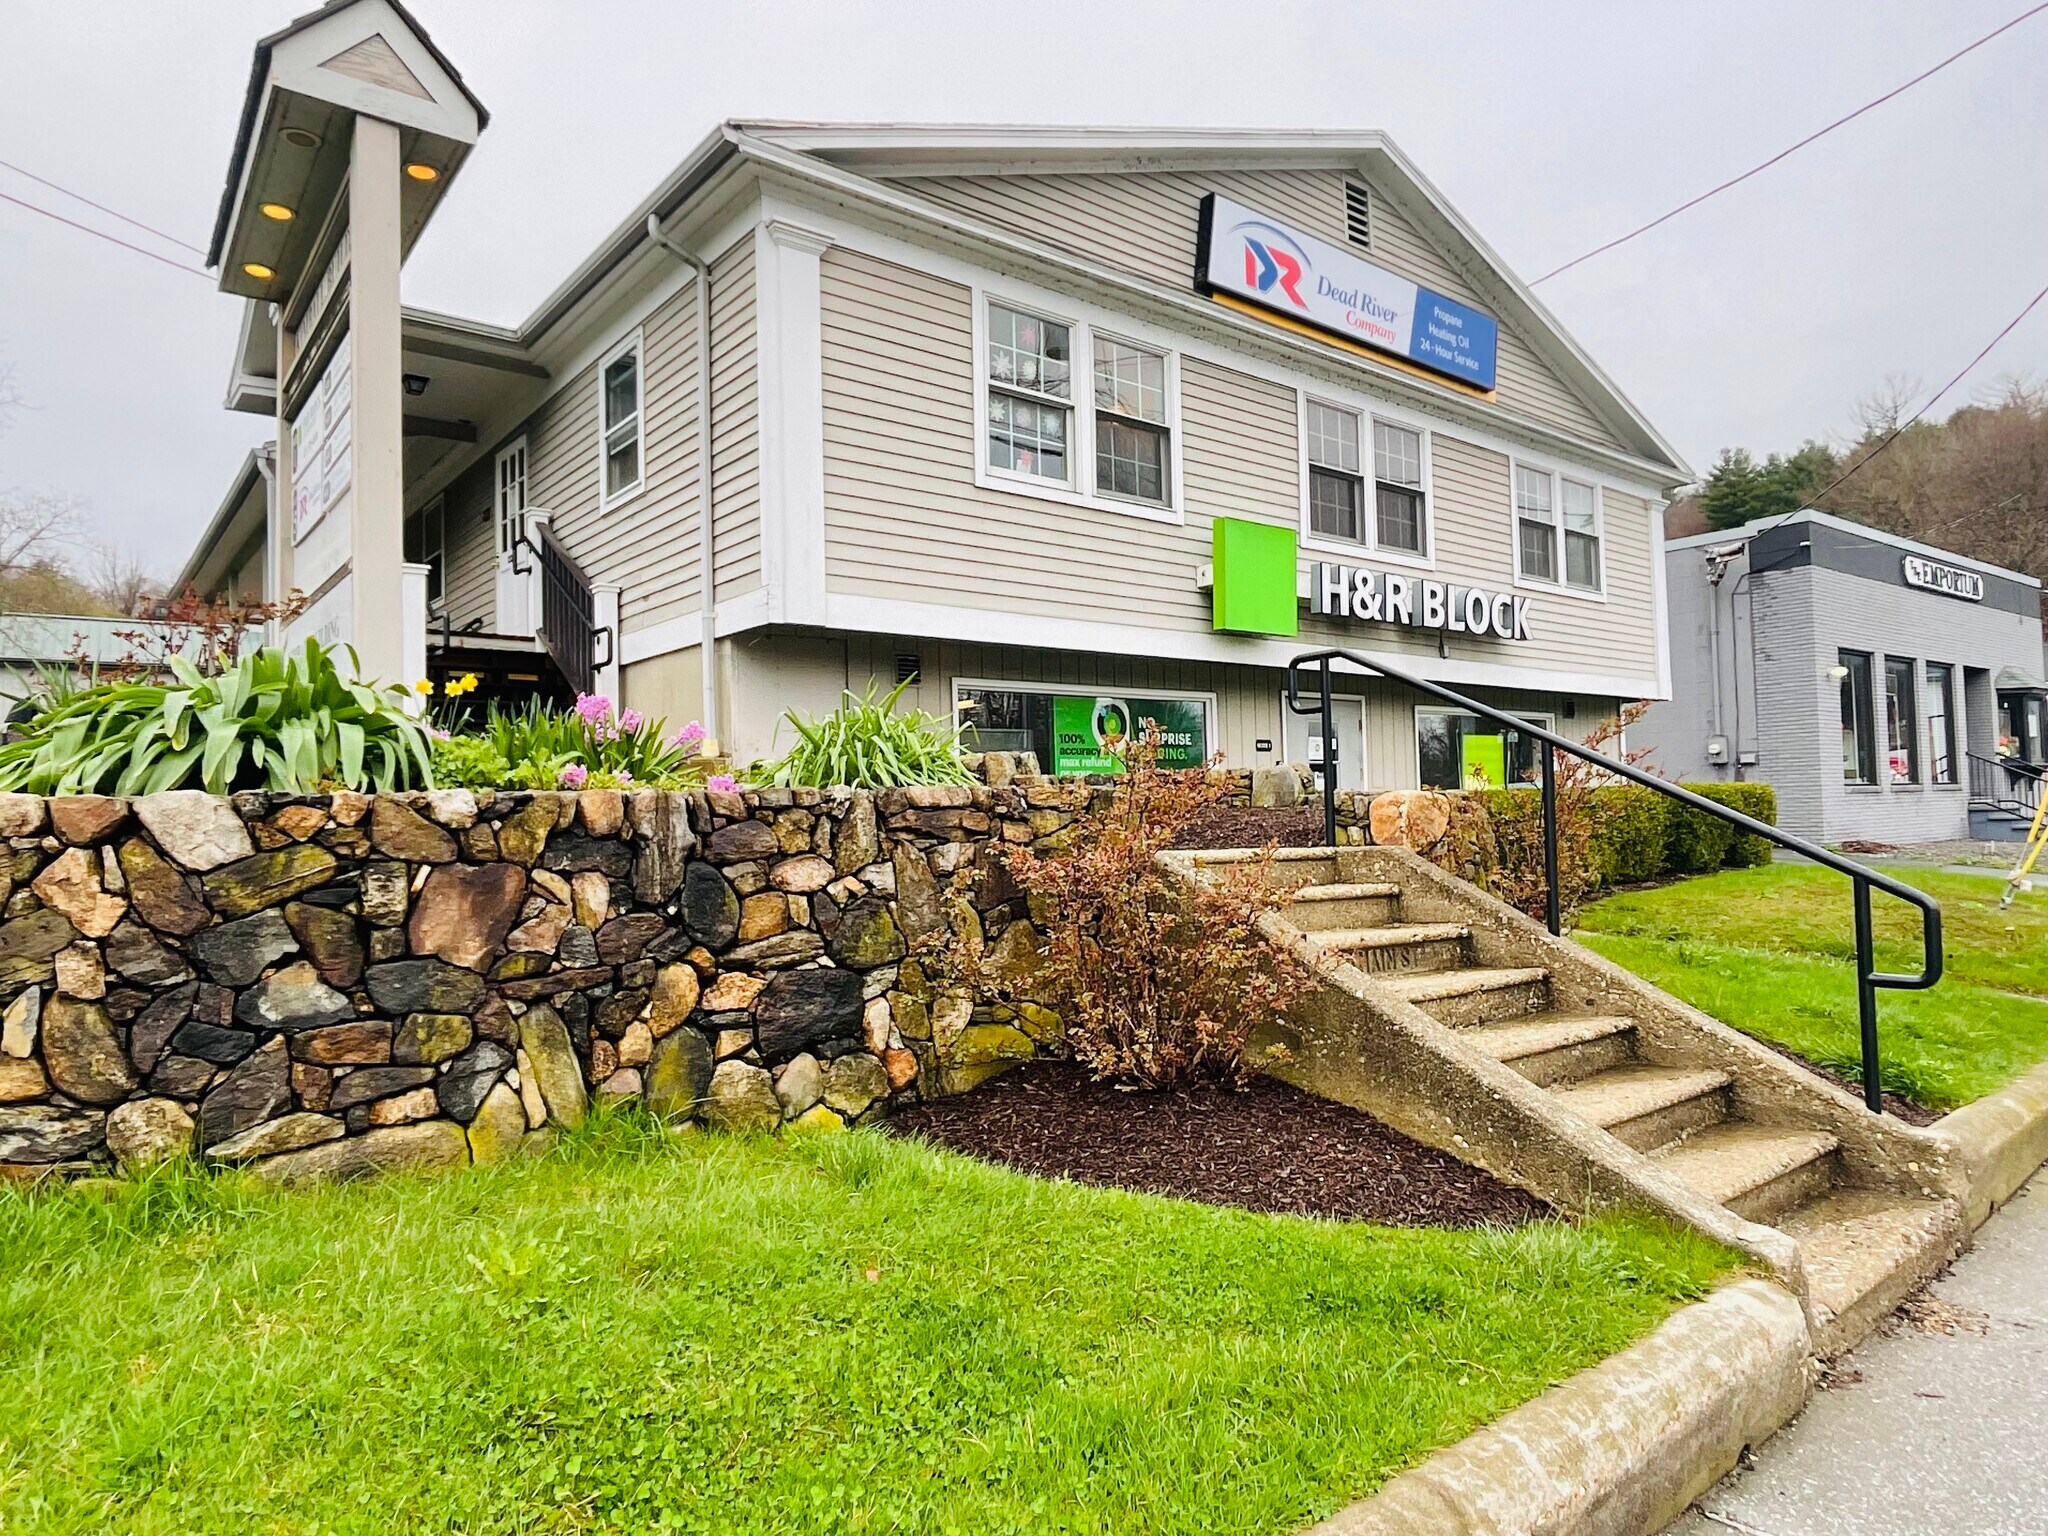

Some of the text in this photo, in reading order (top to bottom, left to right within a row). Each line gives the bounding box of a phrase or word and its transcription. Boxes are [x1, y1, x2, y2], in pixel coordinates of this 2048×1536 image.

[1317, 275, 1398, 323] Dead River
[1346, 310, 1396, 344] Company
[1434, 306, 1462, 328] Propane
[1428, 322, 1470, 349] Heating Oil
[1454, 351, 1479, 371] Service
[1922, 562, 1979, 597] EMPORIUM
[1318, 562, 1534, 640] H&R BLOCK
[1138, 716, 1156, 729] NO
[1058, 733, 1086, 744] 100%
[1059, 747, 1101, 758] accuracy
[1059, 756, 1112, 768] max refund
